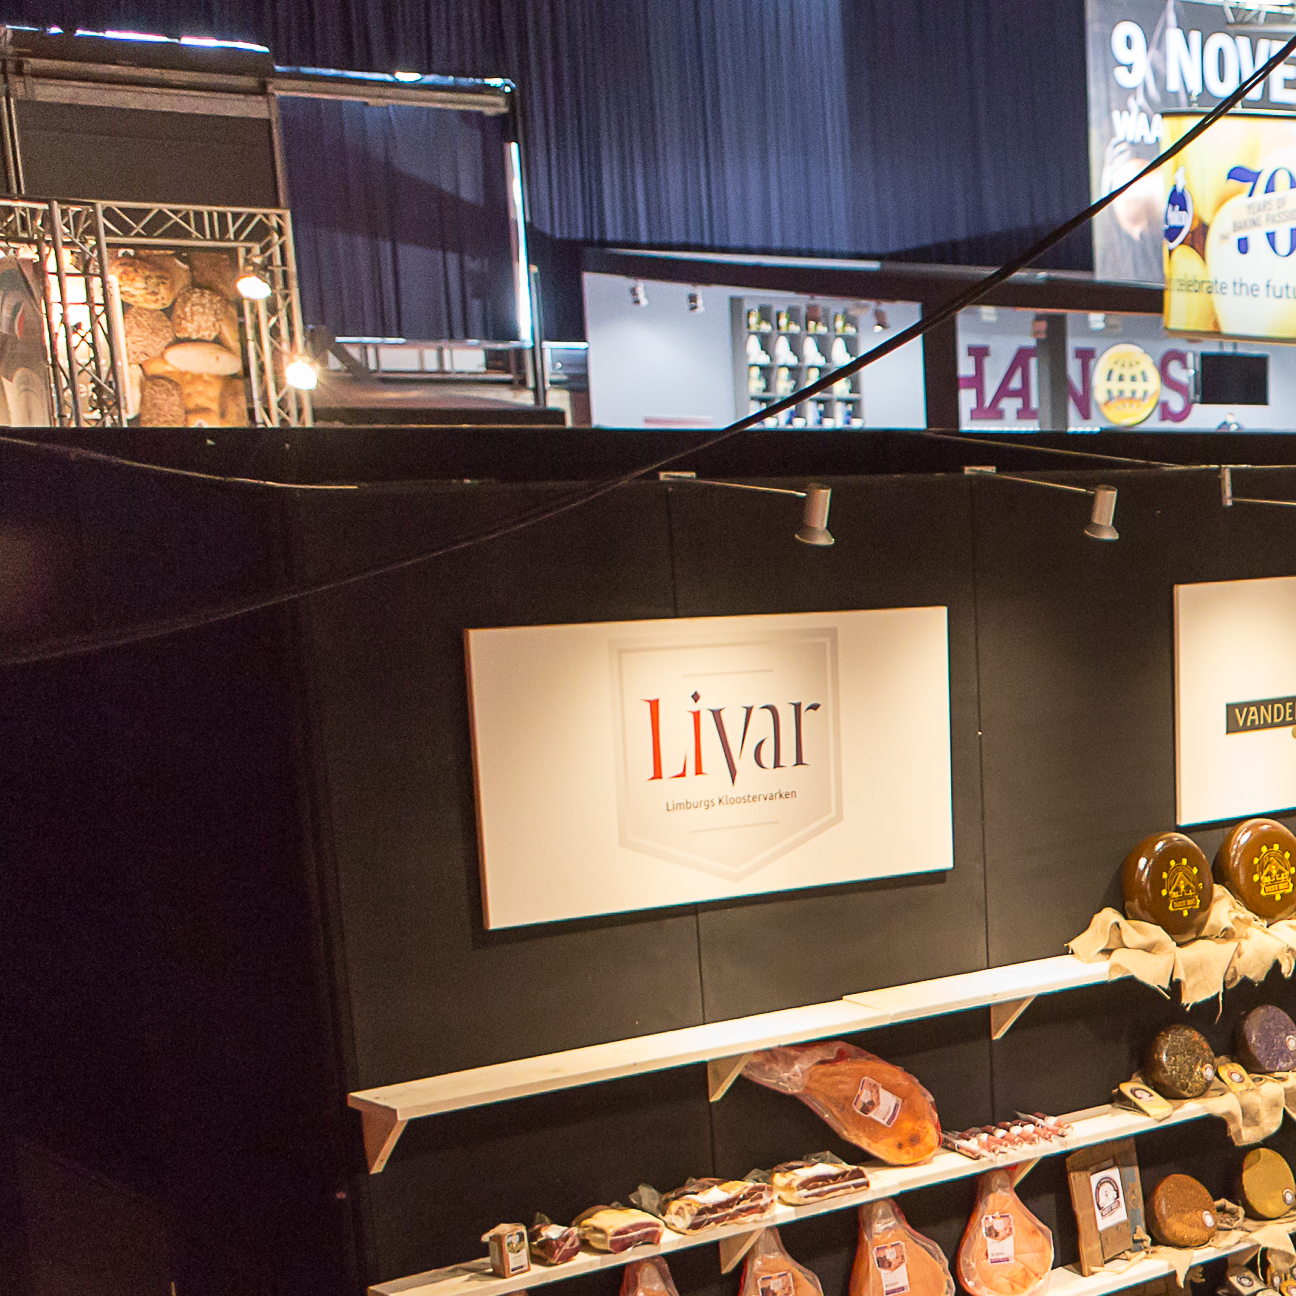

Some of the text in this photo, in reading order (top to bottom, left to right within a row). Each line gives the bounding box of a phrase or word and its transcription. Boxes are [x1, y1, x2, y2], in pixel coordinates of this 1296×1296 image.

[1110, 21, 1148, 89] 9
[1246, 196, 1288, 215] YEARS OF
[1233, 277, 1260, 298] the
[640, 690, 821, 787] Livar
[666, 787, 797, 812] Limburgs Kloostervarken
